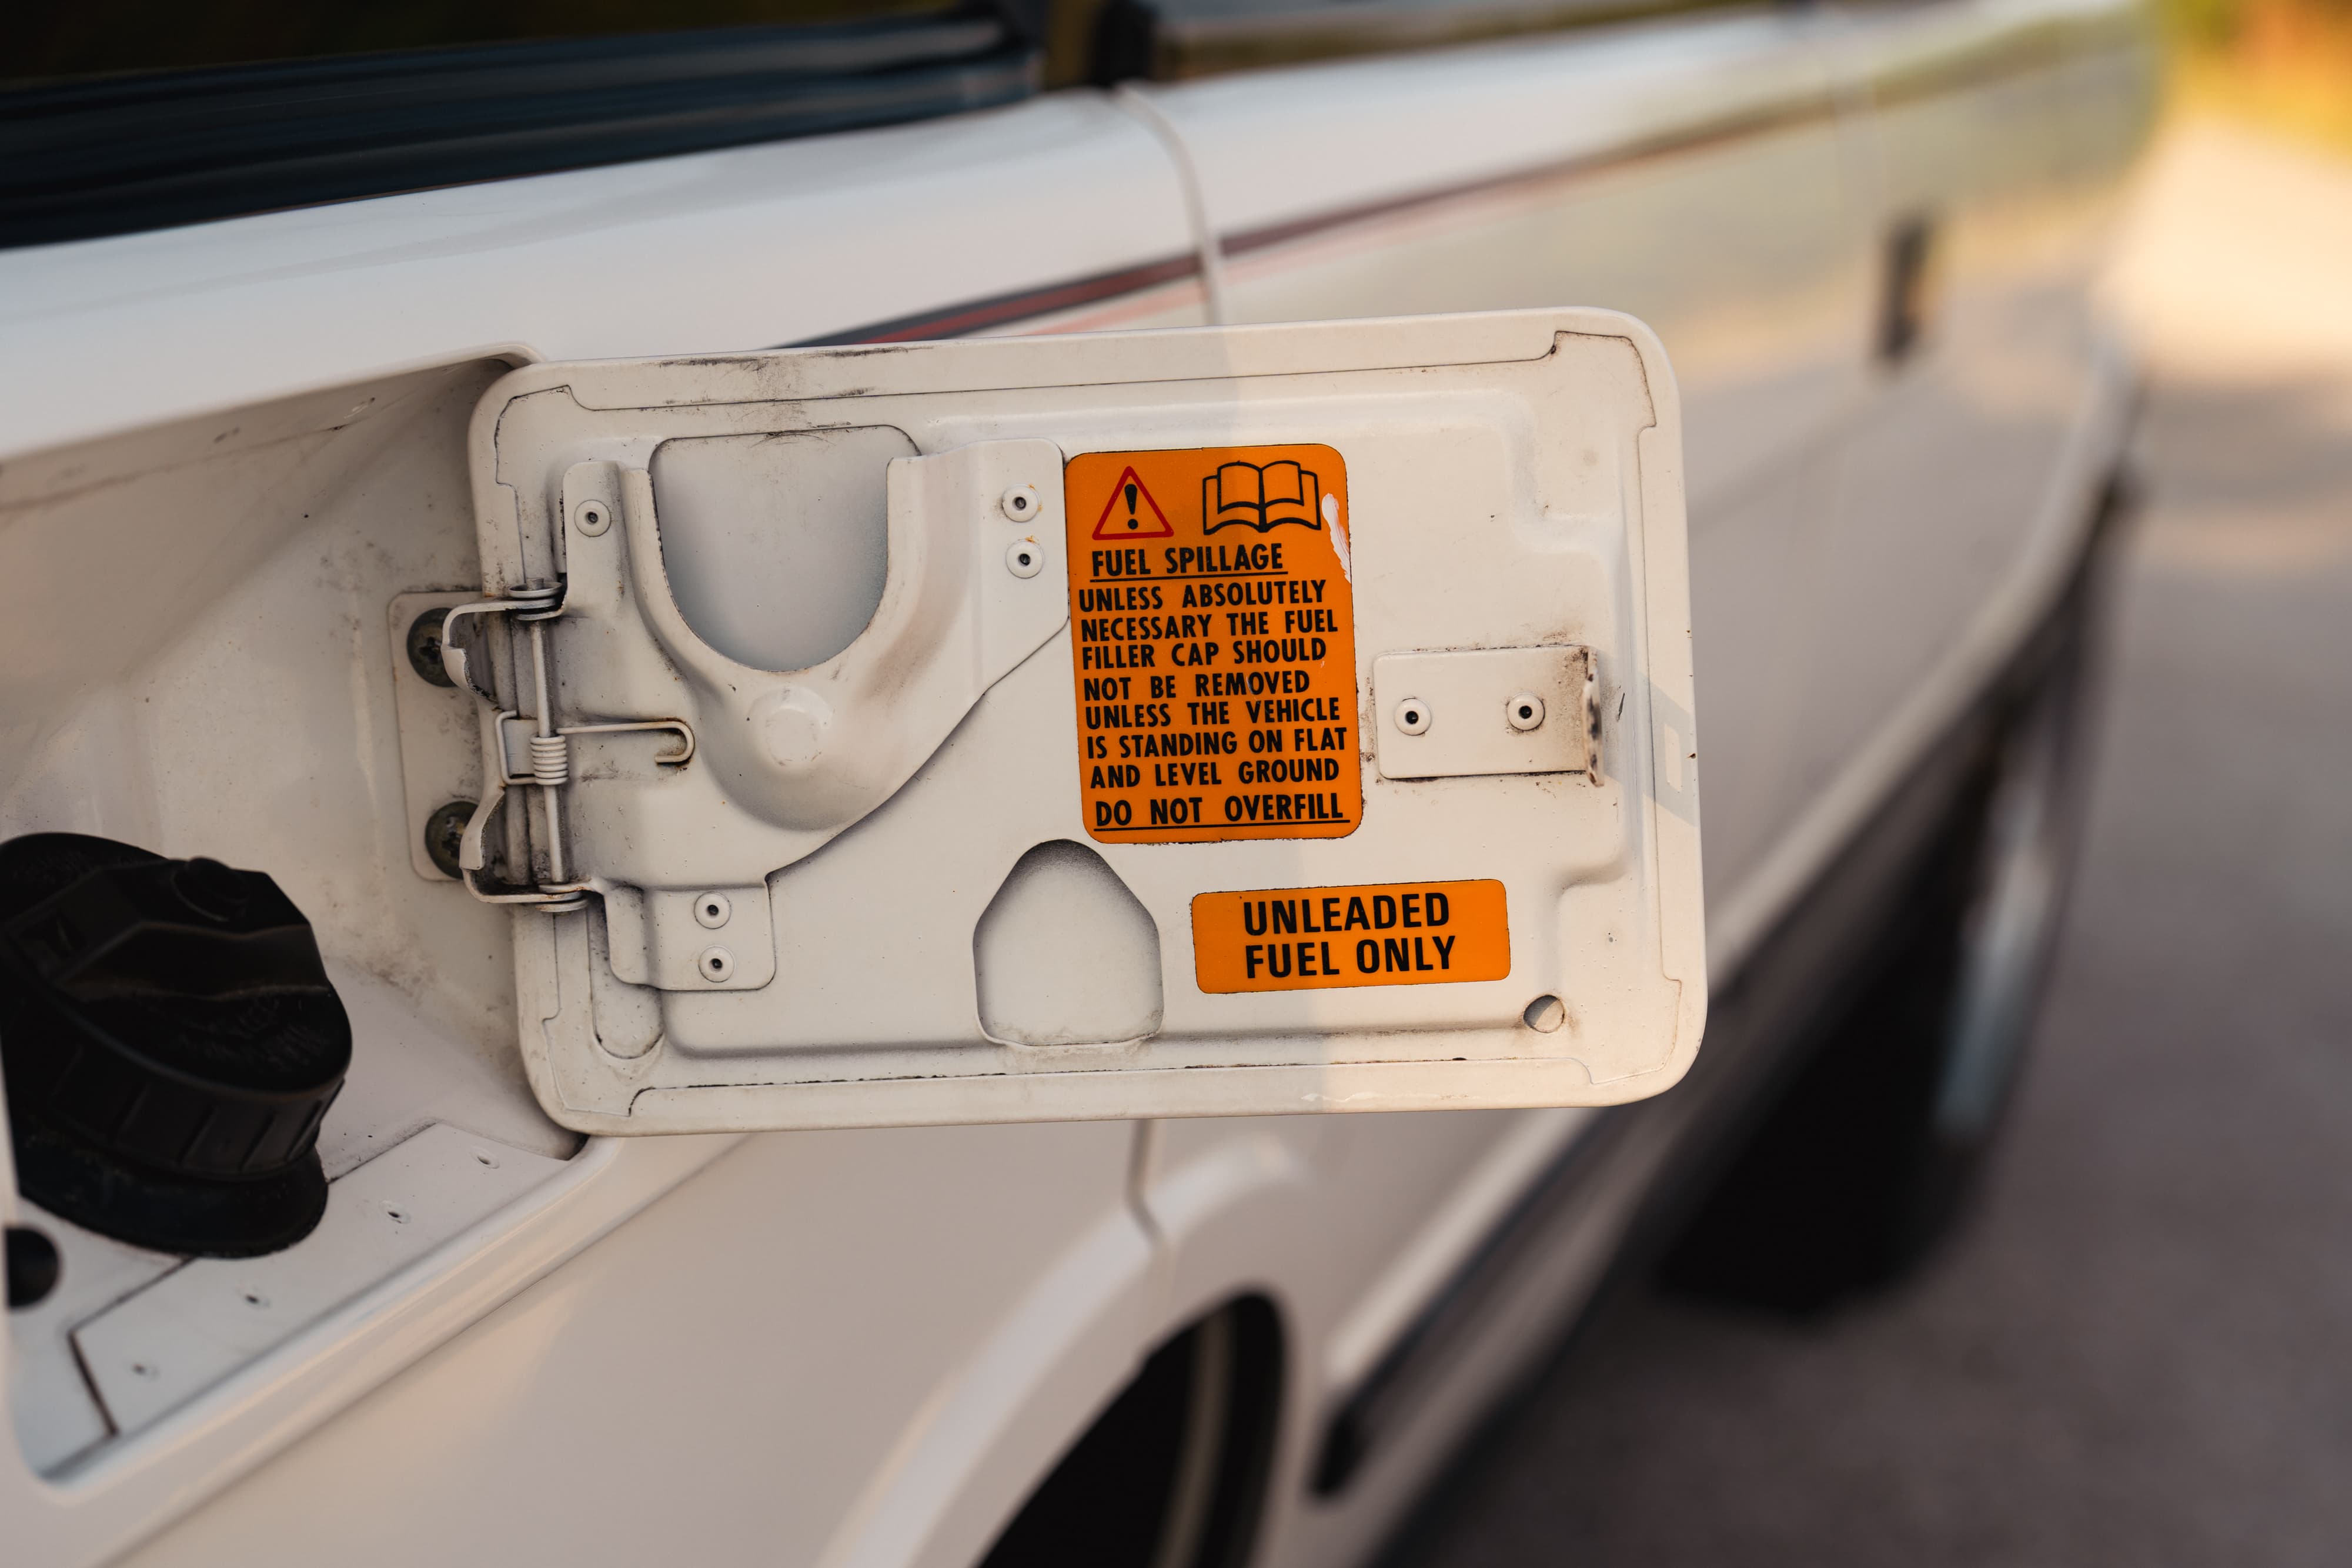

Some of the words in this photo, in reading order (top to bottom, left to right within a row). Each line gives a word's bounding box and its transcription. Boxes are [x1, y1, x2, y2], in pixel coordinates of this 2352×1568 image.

[1092, 549, 1151, 576] FUEL
[1165, 543, 1282, 574] SPILLAGE
[1079, 586, 1162, 612] UNLESS
[1182, 580, 1325, 608] ABSOLUTELY
[1081, 614, 1212, 642] NECESSARY
[1227, 612, 1268, 636] THE
[1285, 610, 1338, 633] FUEL
[1083, 644, 1155, 670] FILLER
[1171, 642, 1219, 666] CAP
[1233, 638, 1326, 664] SHOULD
[1084, 677, 1131, 701] NOT
[1151, 676, 1176, 698] BE
[1195, 670, 1309, 697] REMOVED
[1086, 703, 1171, 730] UNLESS
[1187, 701, 1230, 725] THE
[1245, 697, 1339, 723] VEHICLE
[1087, 736, 1107, 758] IS
[1120, 731, 1237, 758] STANDING
[1249, 730, 1282, 753] ON
[1295, 727, 1347, 751] FLAT
[1091, 765, 1140, 788] AND
[1155, 762, 1221, 786] LEVEL
[1238, 758, 1339, 784] GROUND
[1096, 800, 1131, 826] DO
[1150, 797, 1202, 824] NOT
[1225, 793, 1343, 821] OVERFILL
[1244, 893, 1449, 936] UNLEADED
[1246, 942, 1339, 978] FUEL
[1357, 936, 1455, 973] ONLY
